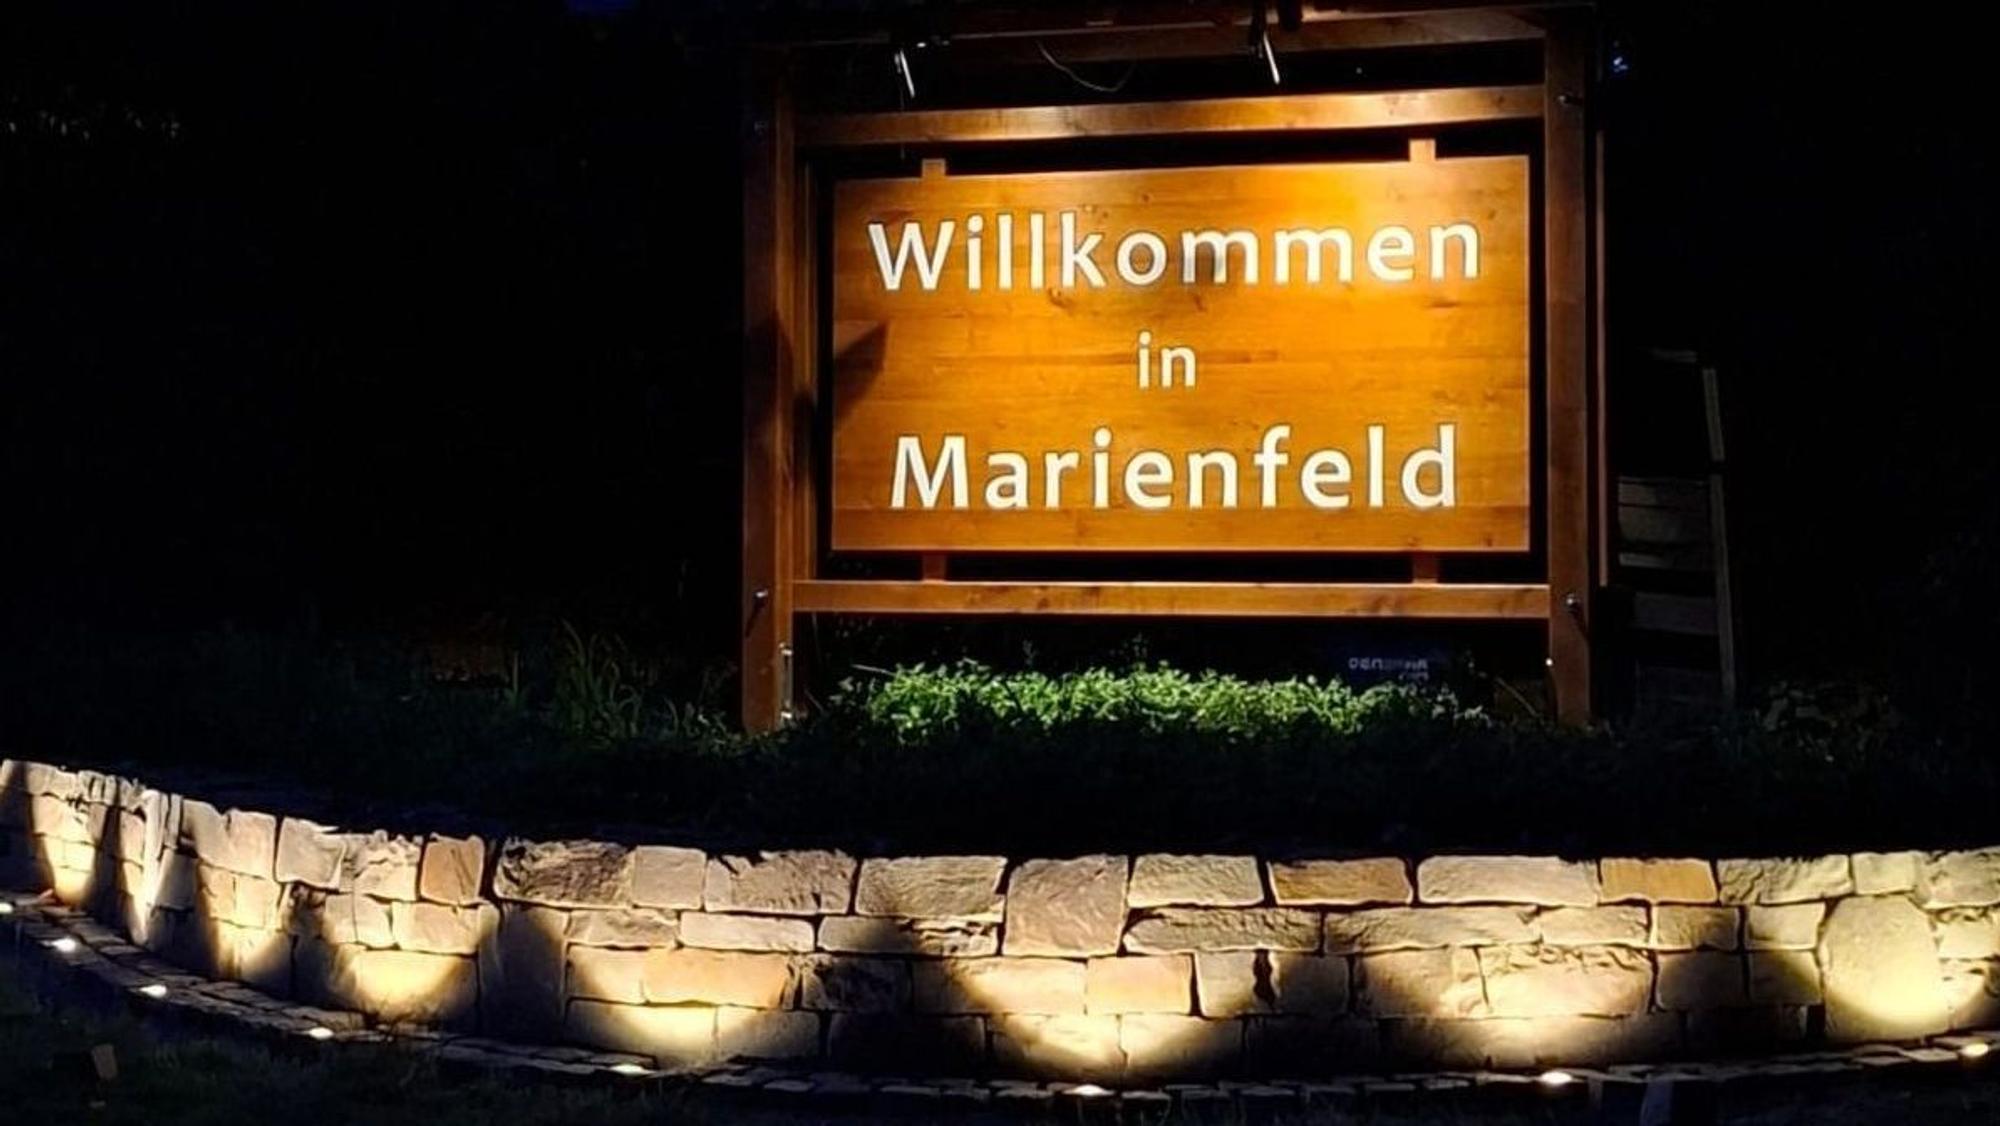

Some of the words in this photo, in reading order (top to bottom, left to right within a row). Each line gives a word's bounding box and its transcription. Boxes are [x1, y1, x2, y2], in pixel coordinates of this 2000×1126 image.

[867, 212, 1480, 290] Willkommen
[1137, 331, 1197, 388] in
[889, 423, 1457, 509] Marienfeld
